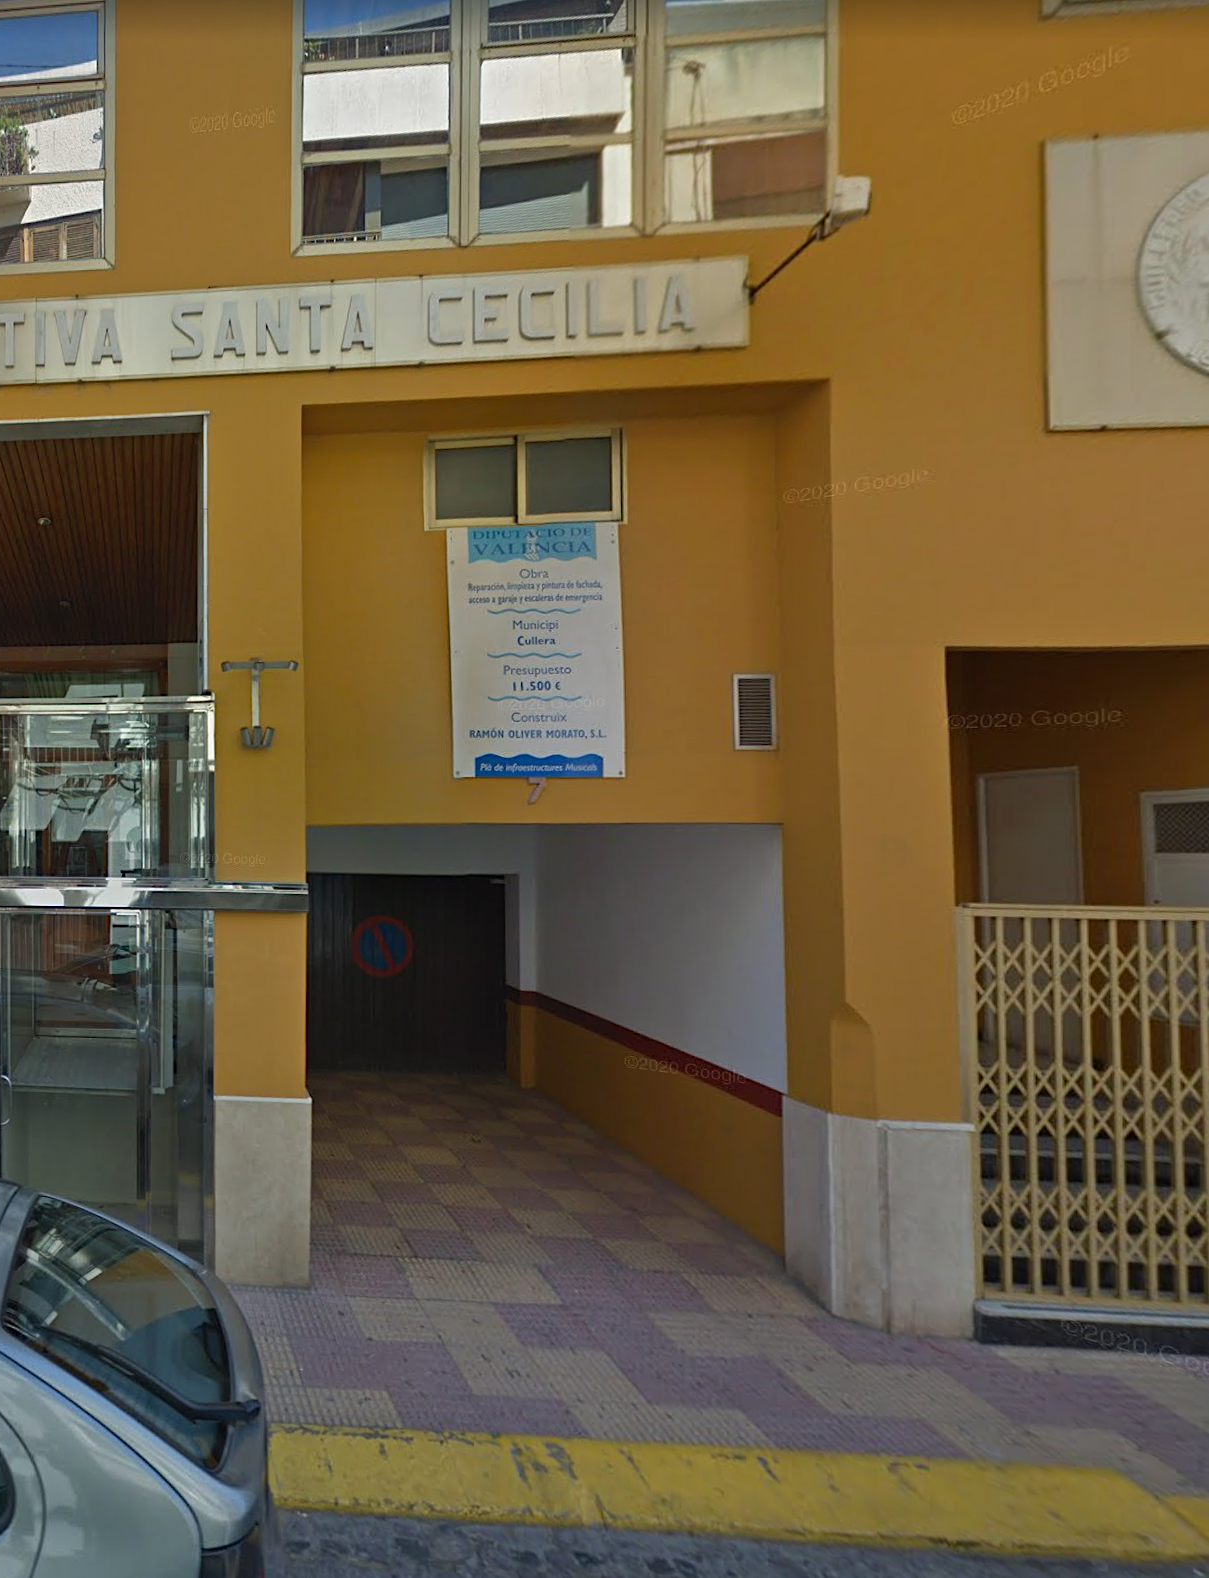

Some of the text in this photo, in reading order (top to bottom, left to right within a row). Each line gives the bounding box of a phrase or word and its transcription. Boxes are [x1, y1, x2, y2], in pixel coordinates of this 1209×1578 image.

[171, 293, 375, 360] SANTA
[427, 274, 696, 346] CECILIA
[570, 526, 592, 537] DE
[519, 568, 549, 579] Obra
[566, 580, 575, 589] de
[468, 596, 491, 604] acceso
[555, 594, 564, 602] de
[565, 593, 603, 604] emergencia
[512, 620, 559, 633] Municipi
[517, 636, 556, 646] Cullera
[503, 664, 572, 677] Presupuesto
[512, 681, 561, 692] 11.500 €
[511, 712, 567, 723] Construix
[469, 727, 607, 740] RAMÓN OLIVER MORATO, S.L.
[494, 763, 504, 771] de
[565, 763, 598, 771] Musicals
[526, 777, 546, 805] 7
